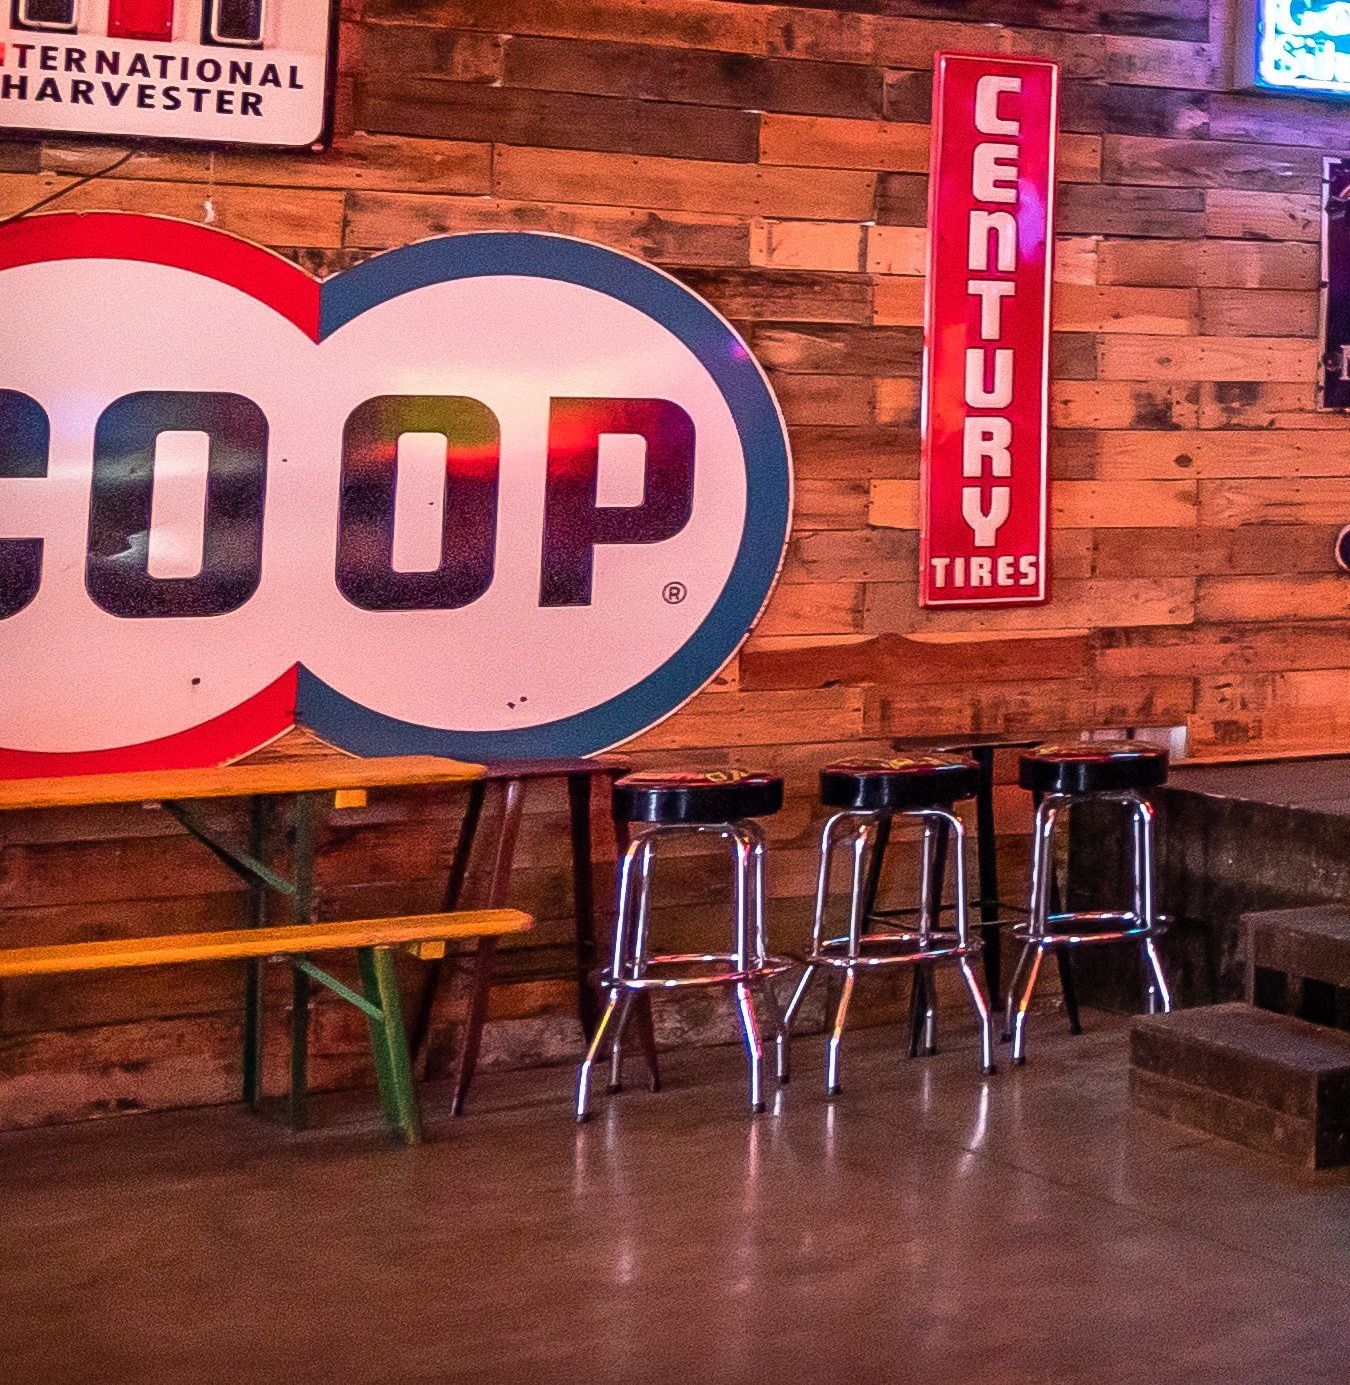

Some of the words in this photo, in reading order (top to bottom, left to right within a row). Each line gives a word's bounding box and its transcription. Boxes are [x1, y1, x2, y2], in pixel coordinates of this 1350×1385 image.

[0, 43, 304, 90] TERNATIONAL
[1, 74, 264, 117] HARVESTER
[961, 74, 1022, 548] CENTURY
[0, 389, 697, 618] OOP
[932, 554, 1038, 589] TIRES
